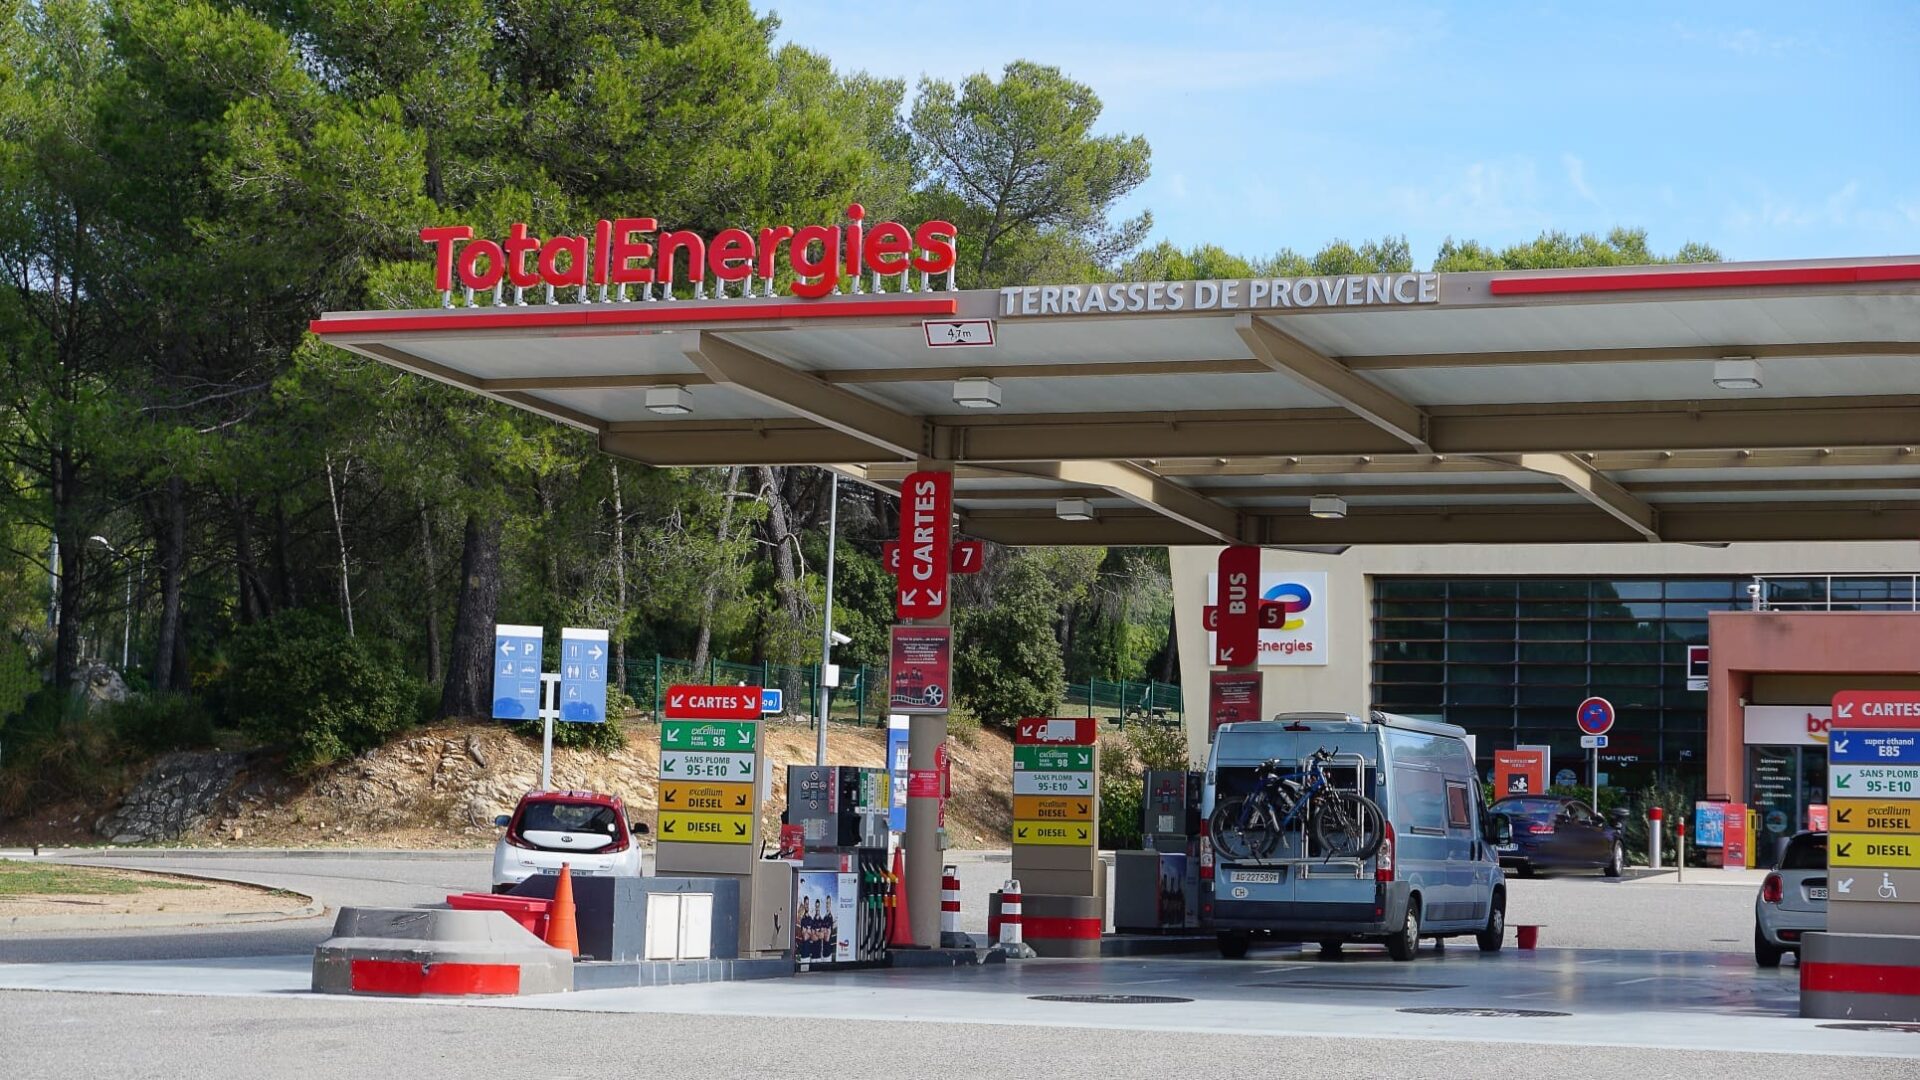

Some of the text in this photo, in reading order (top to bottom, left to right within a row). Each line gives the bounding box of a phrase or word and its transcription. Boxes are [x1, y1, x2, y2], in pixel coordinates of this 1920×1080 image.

[420, 203, 957, 297] TotalEnergies
[1000, 274, 1437, 315] TERRASSES DE PROVENCE
[912, 480, 936, 581] CARTES
[961, 547, 974, 567] 7
[1229, 572, 1247, 614] BUS
[1267, 608, 1278, 624] 5
[688, 695, 738, 709] CARTES
[1861, 702, 1920, 717] CARTES
[712, 736, 726, 747] 98
[1886, 737, 1914, 746] éthanol
[1878, 746, 1901, 757] E85
[684, 756, 703, 764] SANS
[686, 765, 727, 777] 95-E10
[1860, 770, 1919, 778] SANS PLOMB
[1038, 782, 1068, 791] 95-E10
[1866, 781, 1912, 792] 95-E10
[689, 788, 723, 797] excellium
[688, 798, 723, 809] DIESEL
[1038, 809, 1067, 817] DIESEL
[1867, 805, 1911, 816] excellium
[687, 822, 722, 833] DIESEL
[1867, 818, 1911, 829] DIESEL
[1038, 829, 1067, 837] DIESEL
[1866, 845, 1912, 856] DIESEL
